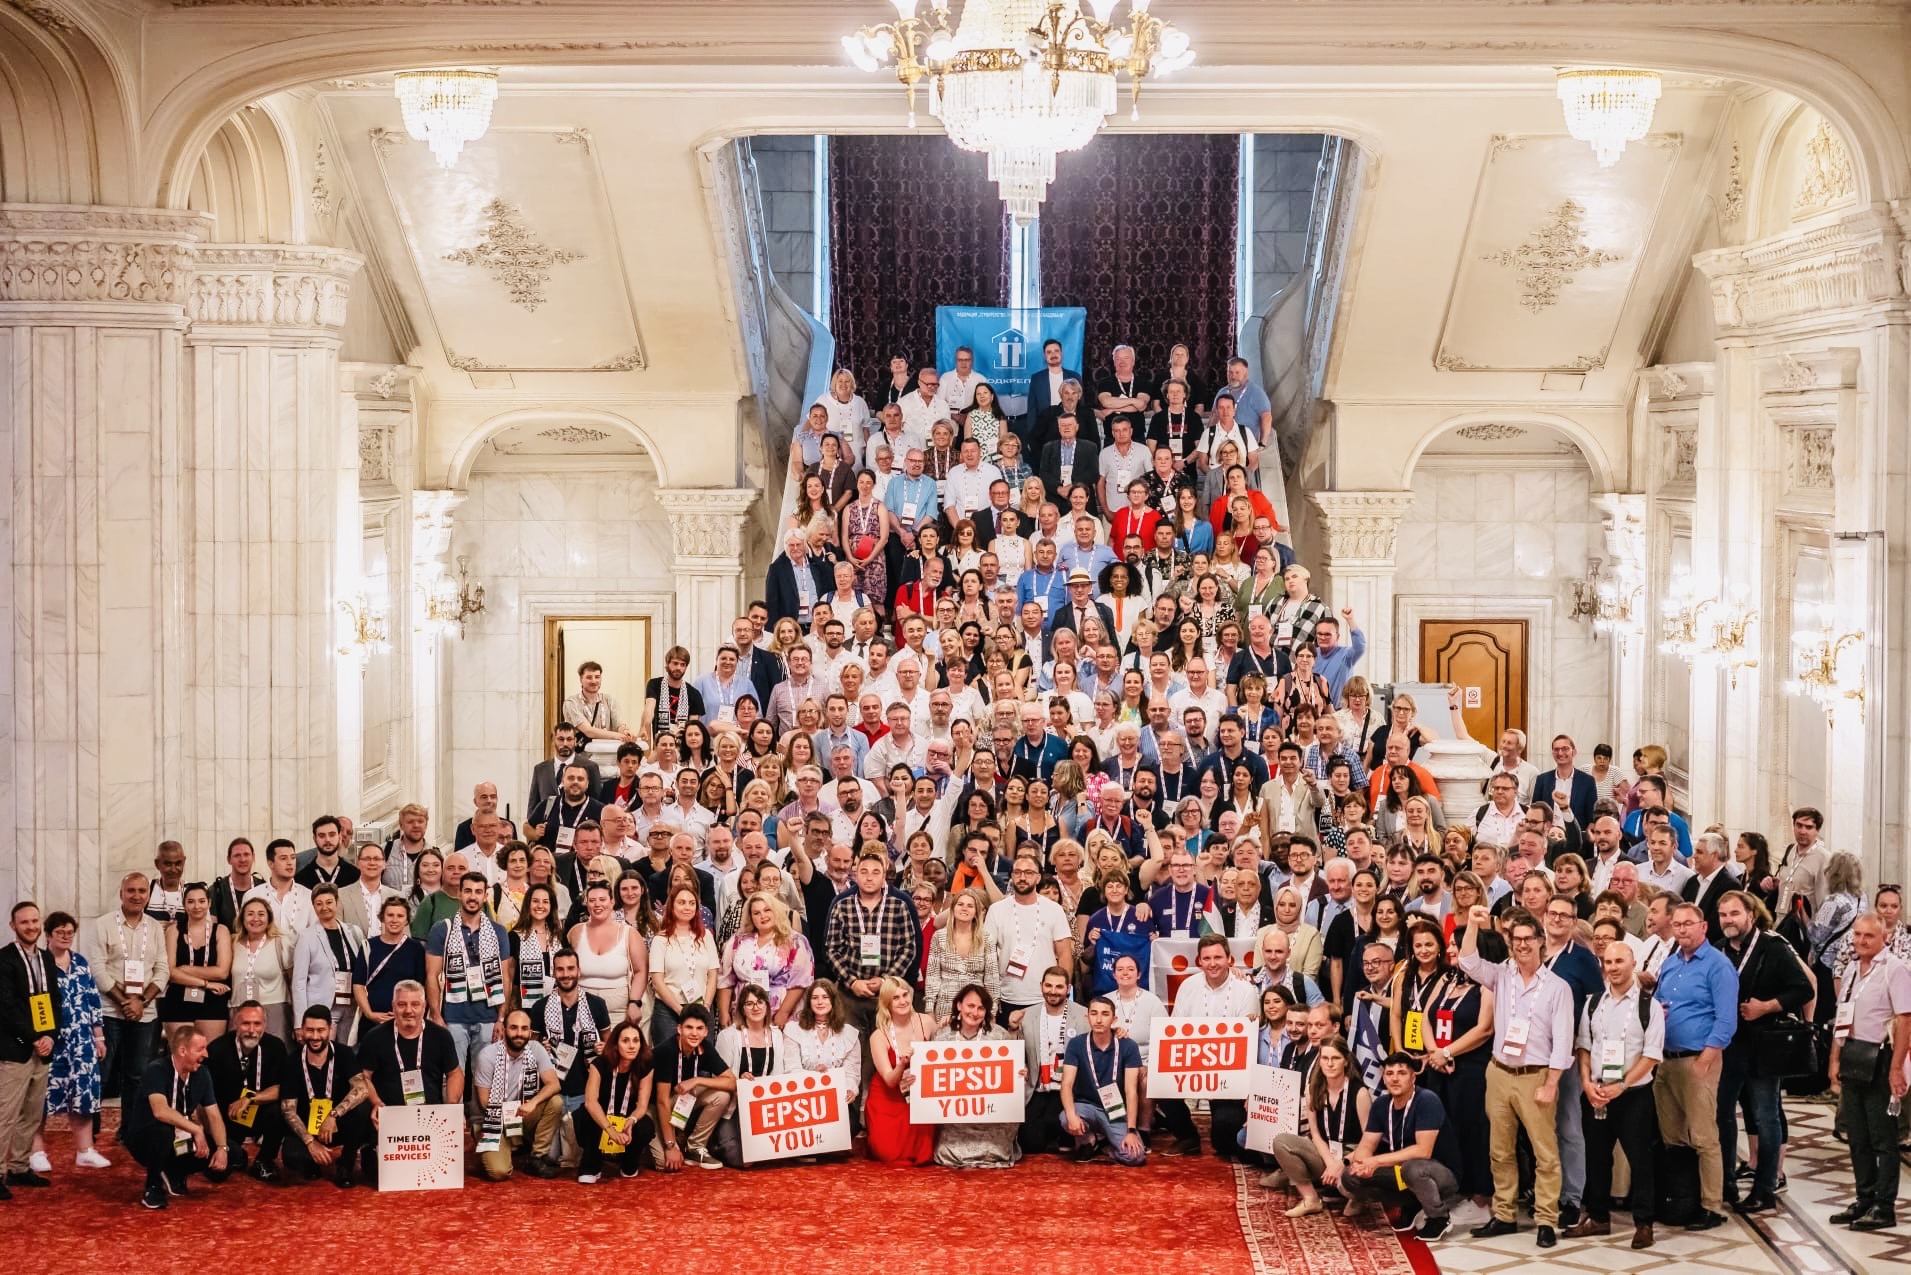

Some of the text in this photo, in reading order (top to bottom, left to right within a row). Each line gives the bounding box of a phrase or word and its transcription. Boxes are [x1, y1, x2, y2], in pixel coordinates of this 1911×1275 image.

[522, 963, 542, 974] FREE
[37, 1000, 47, 1026] STAFF
[1410, 1018, 1419, 1044] STAFF
[1169, 1042, 1236, 1068] EPSU
[933, 1065, 1002, 1092] EPSU
[1253, 1094, 1279, 1105] TIME FOR
[761, 1095, 827, 1128] EPSU
[1258, 1104, 1279, 1115] PUBLIC
[315, 1105, 325, 1130] STAFF
[1250, 1111, 1279, 1124] SERVICES!
[387, 1135, 431, 1143] TIME FOR
[397, 1143, 431, 1152] PUBLIC
[383, 1152, 431, 1162] SERVICES!
